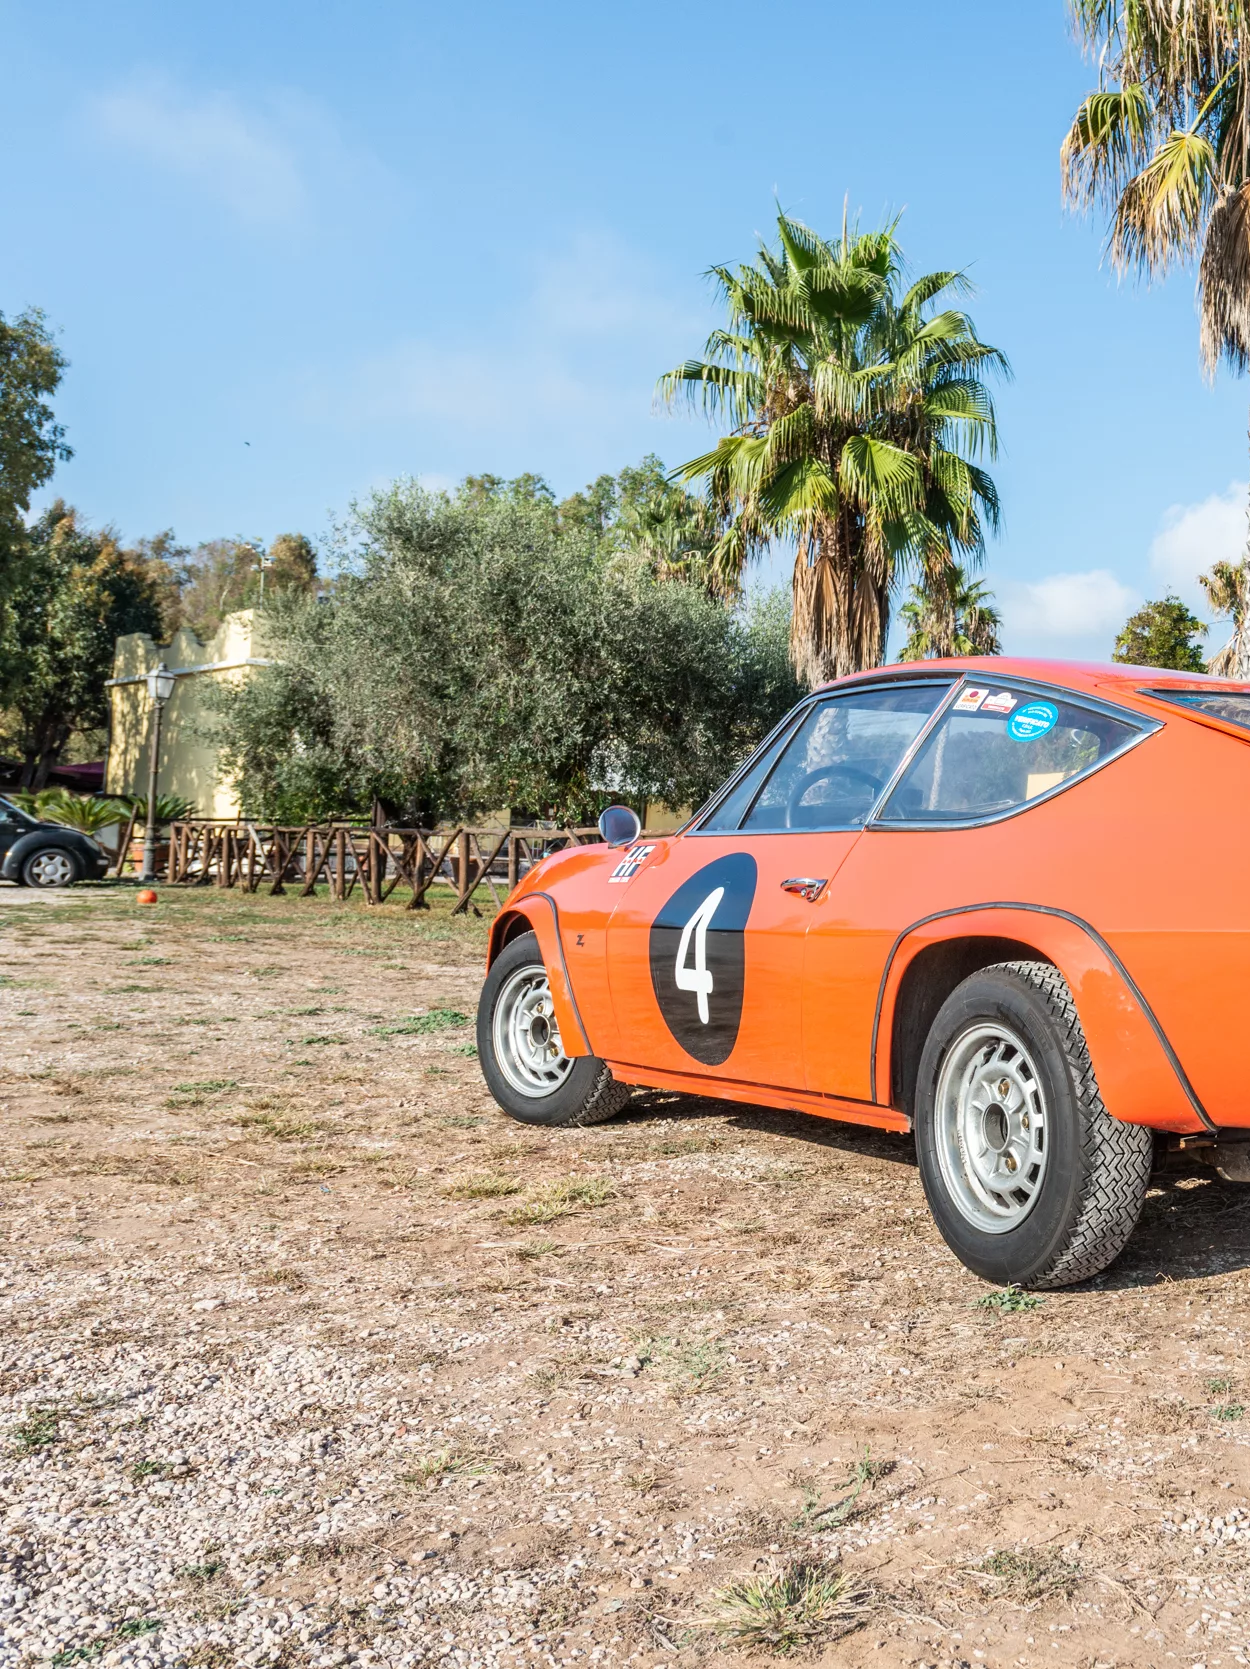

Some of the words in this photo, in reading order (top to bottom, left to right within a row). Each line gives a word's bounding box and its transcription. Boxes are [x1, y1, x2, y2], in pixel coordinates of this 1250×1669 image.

[1014, 715, 1050, 728] VERIFICATO
[611, 844, 657, 877] HF
[675, 886, 725, 1025] 4
